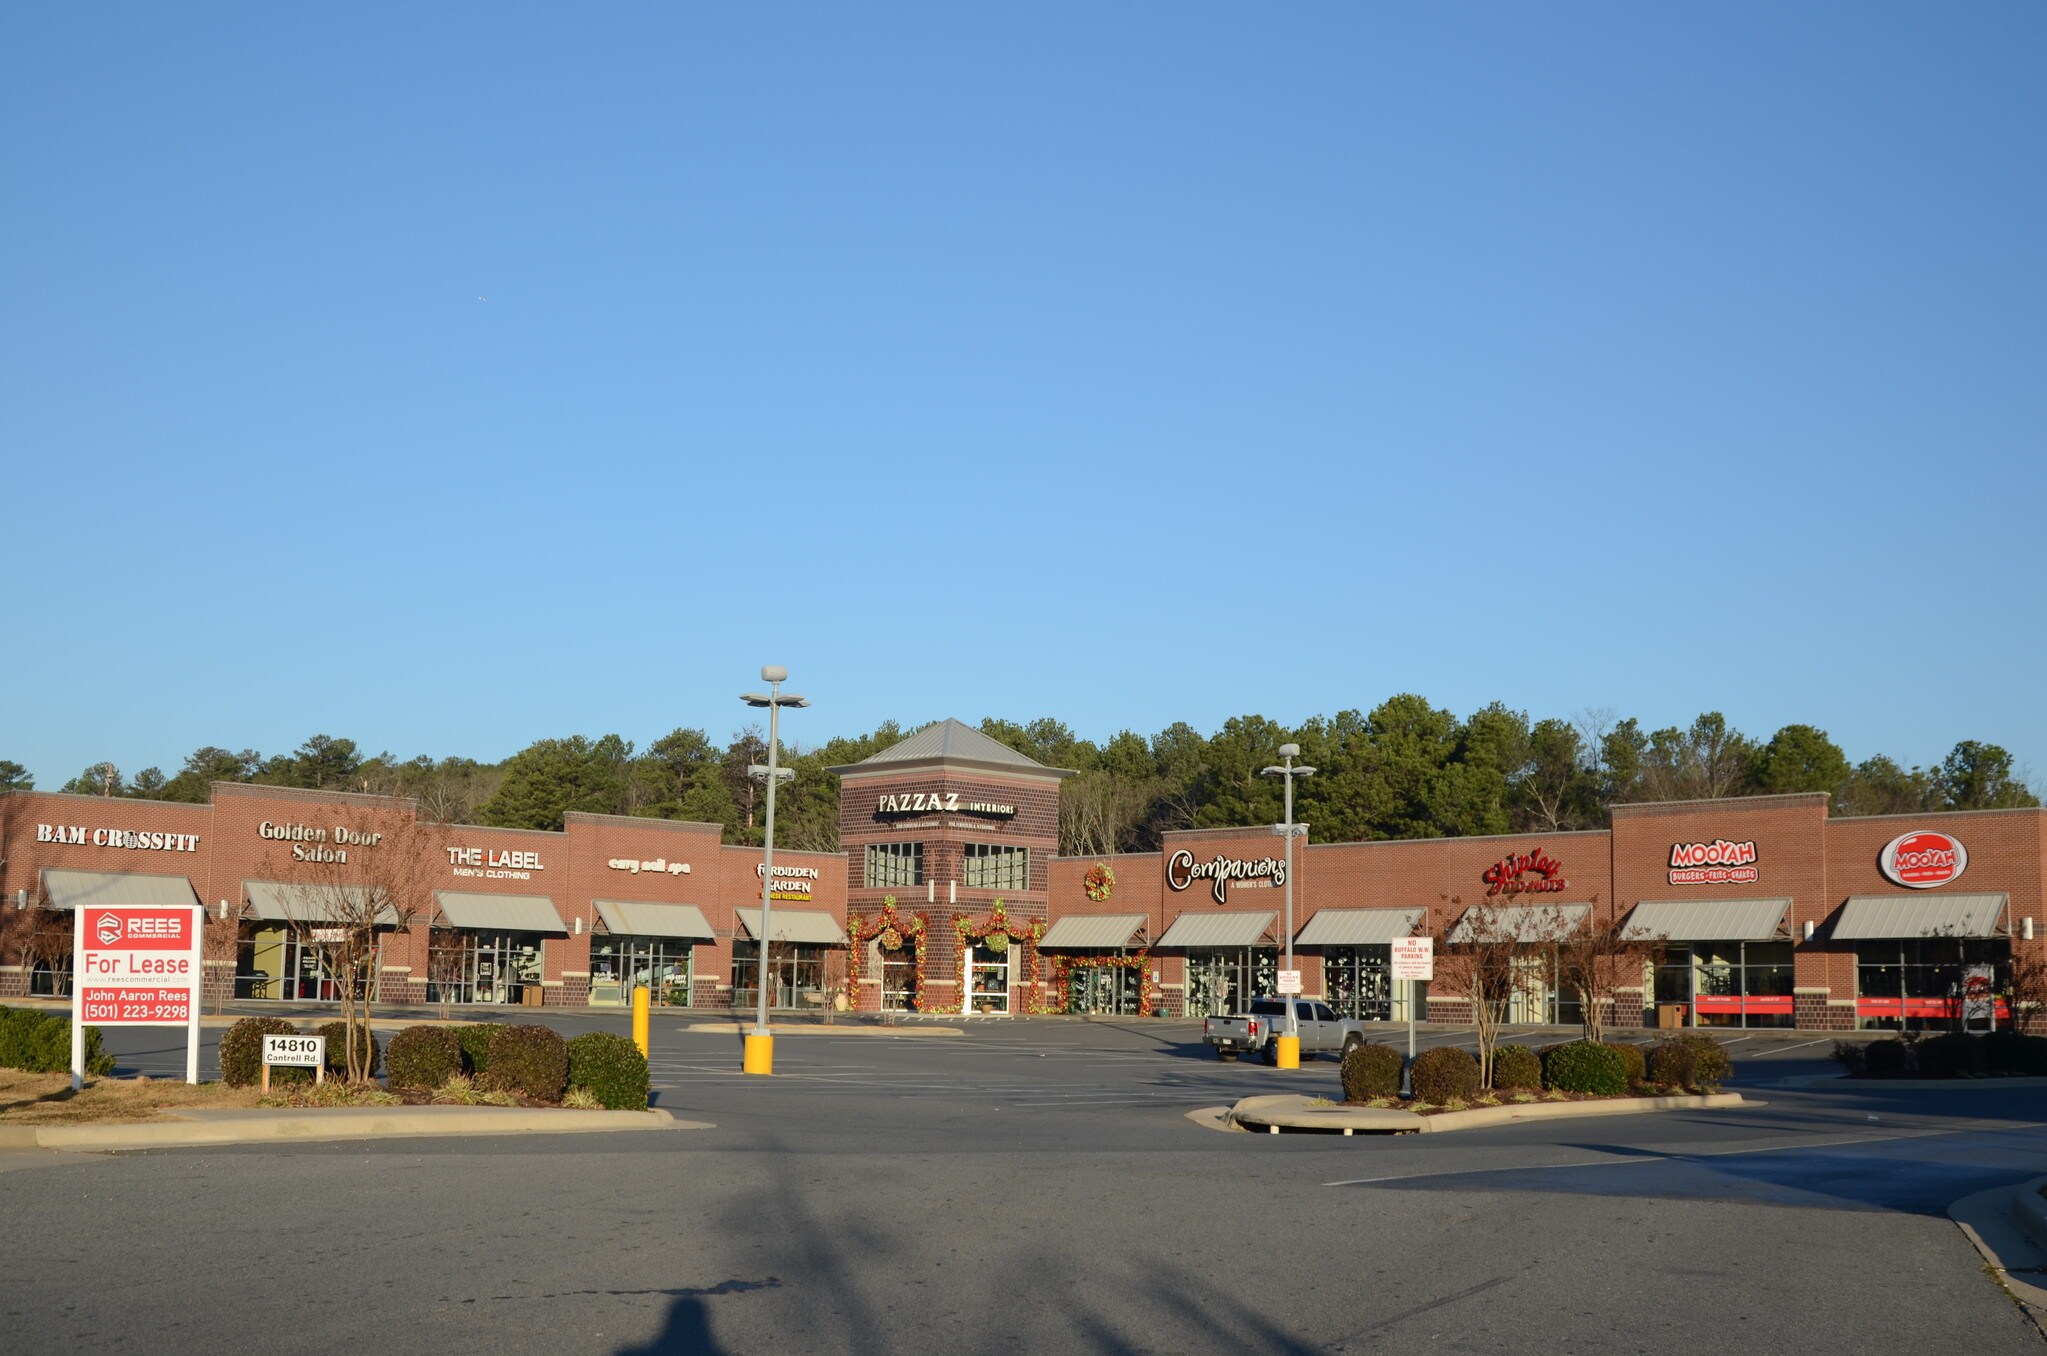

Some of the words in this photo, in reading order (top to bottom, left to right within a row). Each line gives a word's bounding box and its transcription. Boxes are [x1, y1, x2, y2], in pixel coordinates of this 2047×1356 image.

[879, 793, 959, 812] PAZZAZ
[970, 802, 1014, 815] INTERIORS
[37, 824, 87, 845] BAM
[259, 821, 327, 842] Golden
[334, 826, 382, 846] Door
[292, 843, 347, 864] Salon
[447, 847, 482, 866] THE
[488, 849, 544, 870] LABEL
[1671, 840, 1756, 867] MOOYAH
[1892, 849, 1959, 870] MOOYAH
[453, 868, 484, 877] MEN'S
[486, 870, 530, 880] CLOTHING
[667, 863, 691, 875] spa
[756, 863, 819, 879] FRBIDDEN
[1168, 849, 1286, 903] Companions
[1486, 847, 1563, 896] Shipley
[1672, 871, 1705, 881] BURGERS
[1709, 870, 1727, 880] FRIES
[1731, 869, 1755, 878] SHAKES
[127, 918, 182, 933] REES
[1407, 939, 1417, 947] NO
[85, 953, 121, 974] For
[129, 953, 189, 974] Lease
[87, 976, 188, 984] www.reescommercial.com
[86, 990, 115, 1001] John
[118, 990, 155, 1001] Aaron
[158, 990, 188, 1001] Rees
[85, 1003, 118, 1019] (501)
[122, 1005, 188, 1019] 223-9298
[269, 1039, 317, 1053] 14810
[267, 1053, 302, 1062] Cantrell
[304, 1054, 319, 1062] Rd.
